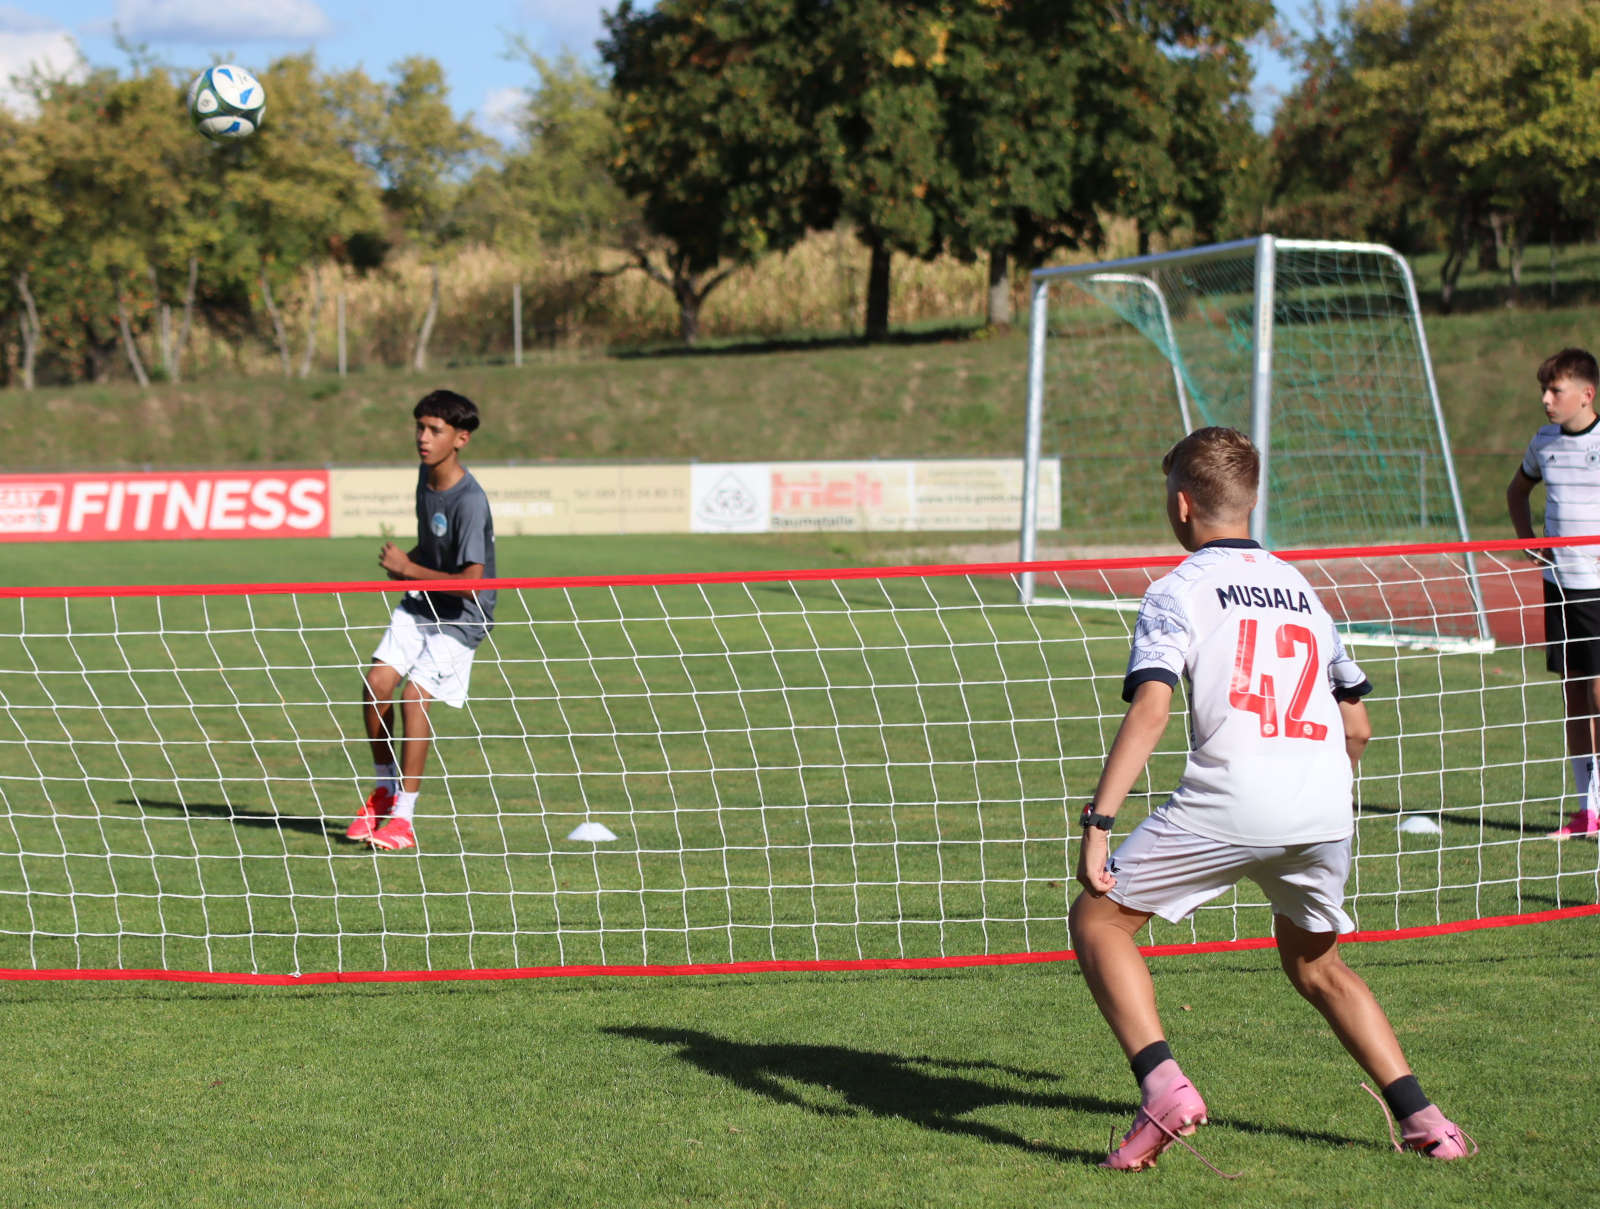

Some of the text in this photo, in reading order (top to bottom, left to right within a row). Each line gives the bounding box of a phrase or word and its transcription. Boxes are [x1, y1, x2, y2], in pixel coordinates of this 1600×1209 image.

[67, 479, 326, 532] FITNESS
[1216, 585, 1312, 614] MUSIALA
[1229, 619, 1328, 741] 42
